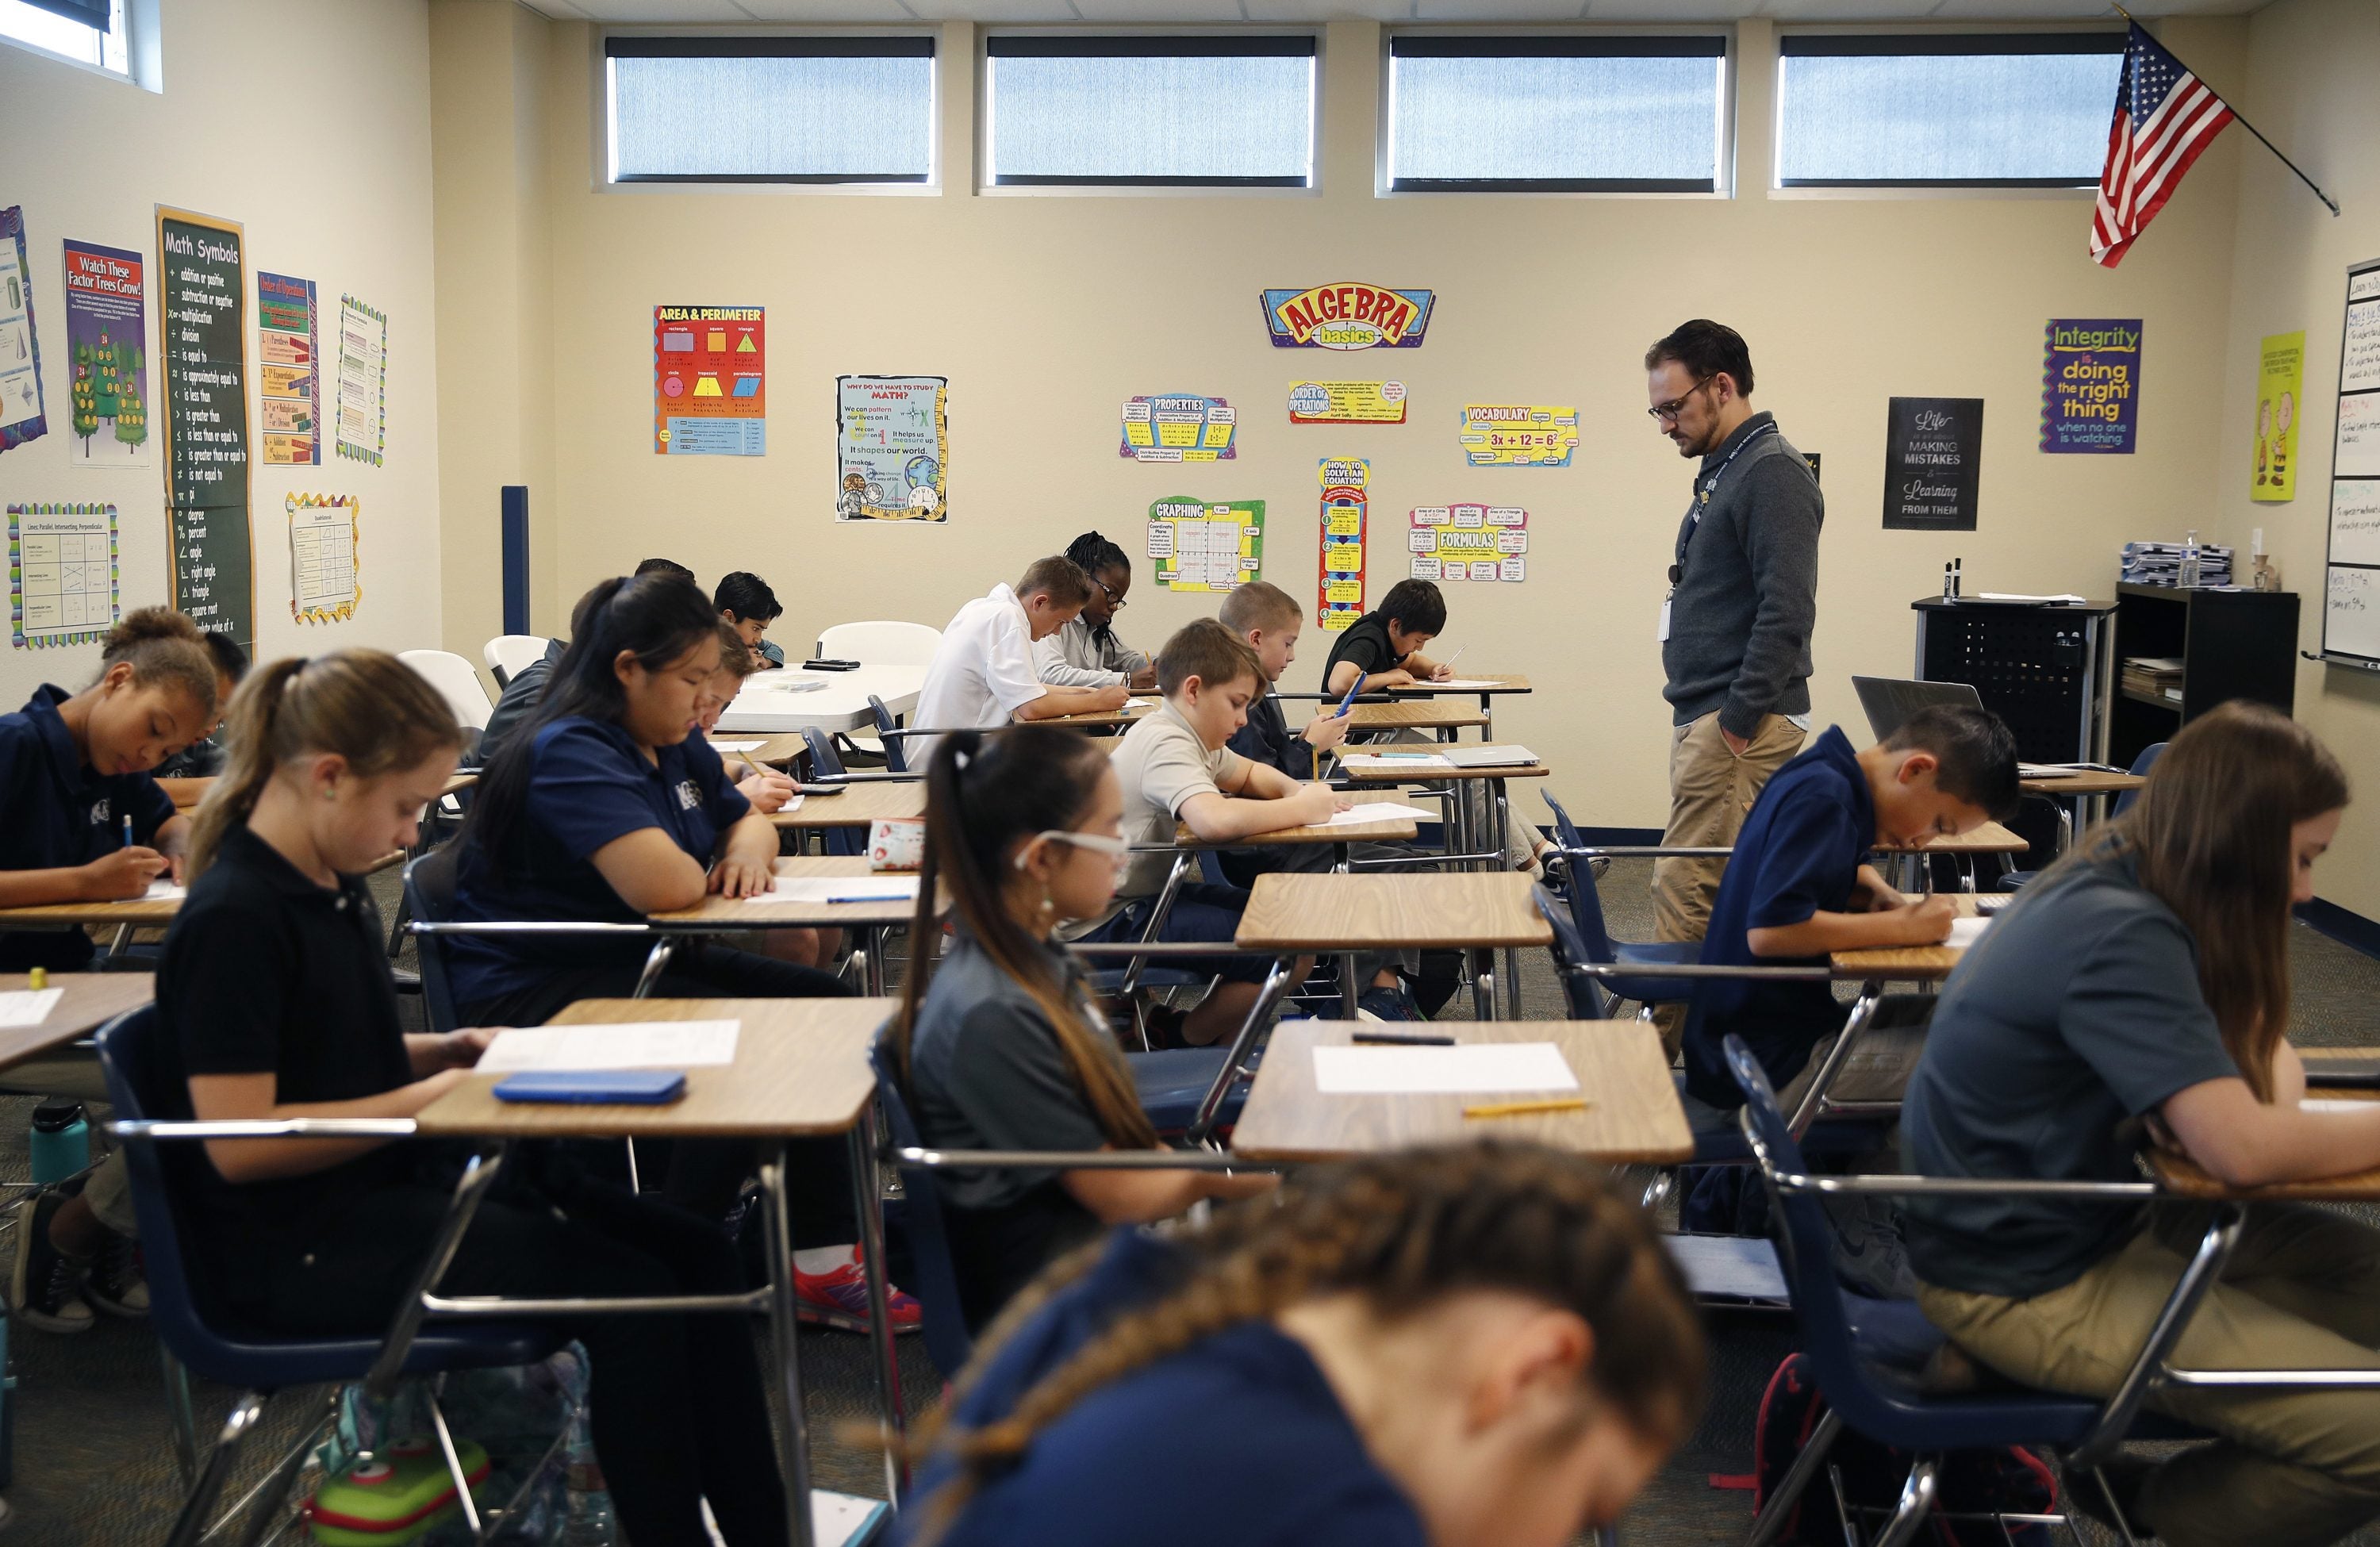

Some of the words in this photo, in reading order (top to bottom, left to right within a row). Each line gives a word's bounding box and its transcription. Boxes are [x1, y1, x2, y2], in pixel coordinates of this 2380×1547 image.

[166, 232, 193, 256] Math
[198, 239, 238, 265] Symbols
[80, 257, 106, 274] Watch
[108, 261, 129, 278] These
[69, 271, 94, 288] Factor
[95, 275, 116, 291] Trees
[118, 279, 141, 296] Grow!
[181, 267, 199, 283] addition
[201, 274, 206, 284] or
[208, 273, 224, 289] positive
[181, 287, 208, 304] subtraction
[209, 295, 214, 305] or
[215, 294, 233, 310] negative
[181, 307, 212, 326] multiplication
[659, 308, 689, 320] AREA
[690, 309, 699, 320] &
[701, 309, 761, 321] PERIMETER
[1284, 288, 1409, 338] ALGEBRA
[102, 335, 107, 344] 24
[182, 327, 199, 343] division
[1320, 326, 1375, 344] basics
[2054, 327, 2139, 349] Integrity
[182, 348, 187, 361] is
[188, 349, 200, 365] equal
[201, 351, 207, 363] to
[2082, 353, 2092, 363] is
[79, 367, 85, 376] 24
[183, 368, 187, 381] is
[189, 370, 219, 387] approximately
[220, 371, 231, 388] equal
[232, 373, 238, 386] to
[2063, 361, 2127, 383] doing
[127, 384, 133, 392] 24
[184, 388, 189, 401] is
[190, 387, 199, 402] less
[200, 388, 211, 403] than
[871, 391, 908, 400] MATH?
[1295, 388, 1317, 398] ORDER
[1317, 390, 1325, 398] OF
[2058, 382, 2077, 393] the
[2079, 380, 2131, 403] right
[1154, 399, 1204, 410] PROPERTIES
[1289, 400, 1329, 411] OPERATIONS
[2063, 399, 2119, 421] thing
[186, 408, 191, 421] is
[192, 411, 209, 425] greater
[210, 408, 220, 423] than
[1469, 408, 1529, 420] VOCABULARY
[1915, 410, 1953, 431] Life
[2056, 422, 2086, 432] when
[187, 428, 192, 441] is
[193, 427, 203, 442] less
[203, 428, 214, 442] than
[215, 432, 219, 442] or
[221, 428, 232, 446] equal
[232, 430, 238, 443] to
[1491, 434, 1503, 445] 3x
[1520, 435, 1532, 445] 12
[2060, 433, 2069, 443] is
[2073, 433, 2124, 445] watching.
[1909, 442, 1957, 452] MAKING
[188, 448, 193, 461] is
[194, 450, 212, 465] greater
[213, 448, 223, 461] than
[224, 451, 229, 461] or
[230, 448, 241, 465] equal
[241, 449, 246, 462] to
[1905, 454, 1960, 465] MISTAKES
[189, 467, 194, 480] is
[205, 467, 217, 485] equal
[218, 469, 223, 481] to
[190, 486, 195, 504] pi
[1903, 479, 1957, 502] Learning
[188, 508, 205, 525] degree
[1156, 503, 1203, 517] GRAPHING
[1902, 505, 1929, 514] FROM
[1932, 506, 1958, 515] THEM
[188, 526, 207, 543] percent
[1440, 533, 1494, 547] FORMULAS
[190, 544, 202, 562] angle
[191, 564, 203, 582] right
[204, 563, 216, 581] angle
[192, 583, 209, 600] triangle
[191, 605, 207, 620] square
[208, 602, 218, 615] root
[212, 619, 223, 632] value
[224, 618, 229, 632] of
[230, 621, 234, 631] x
